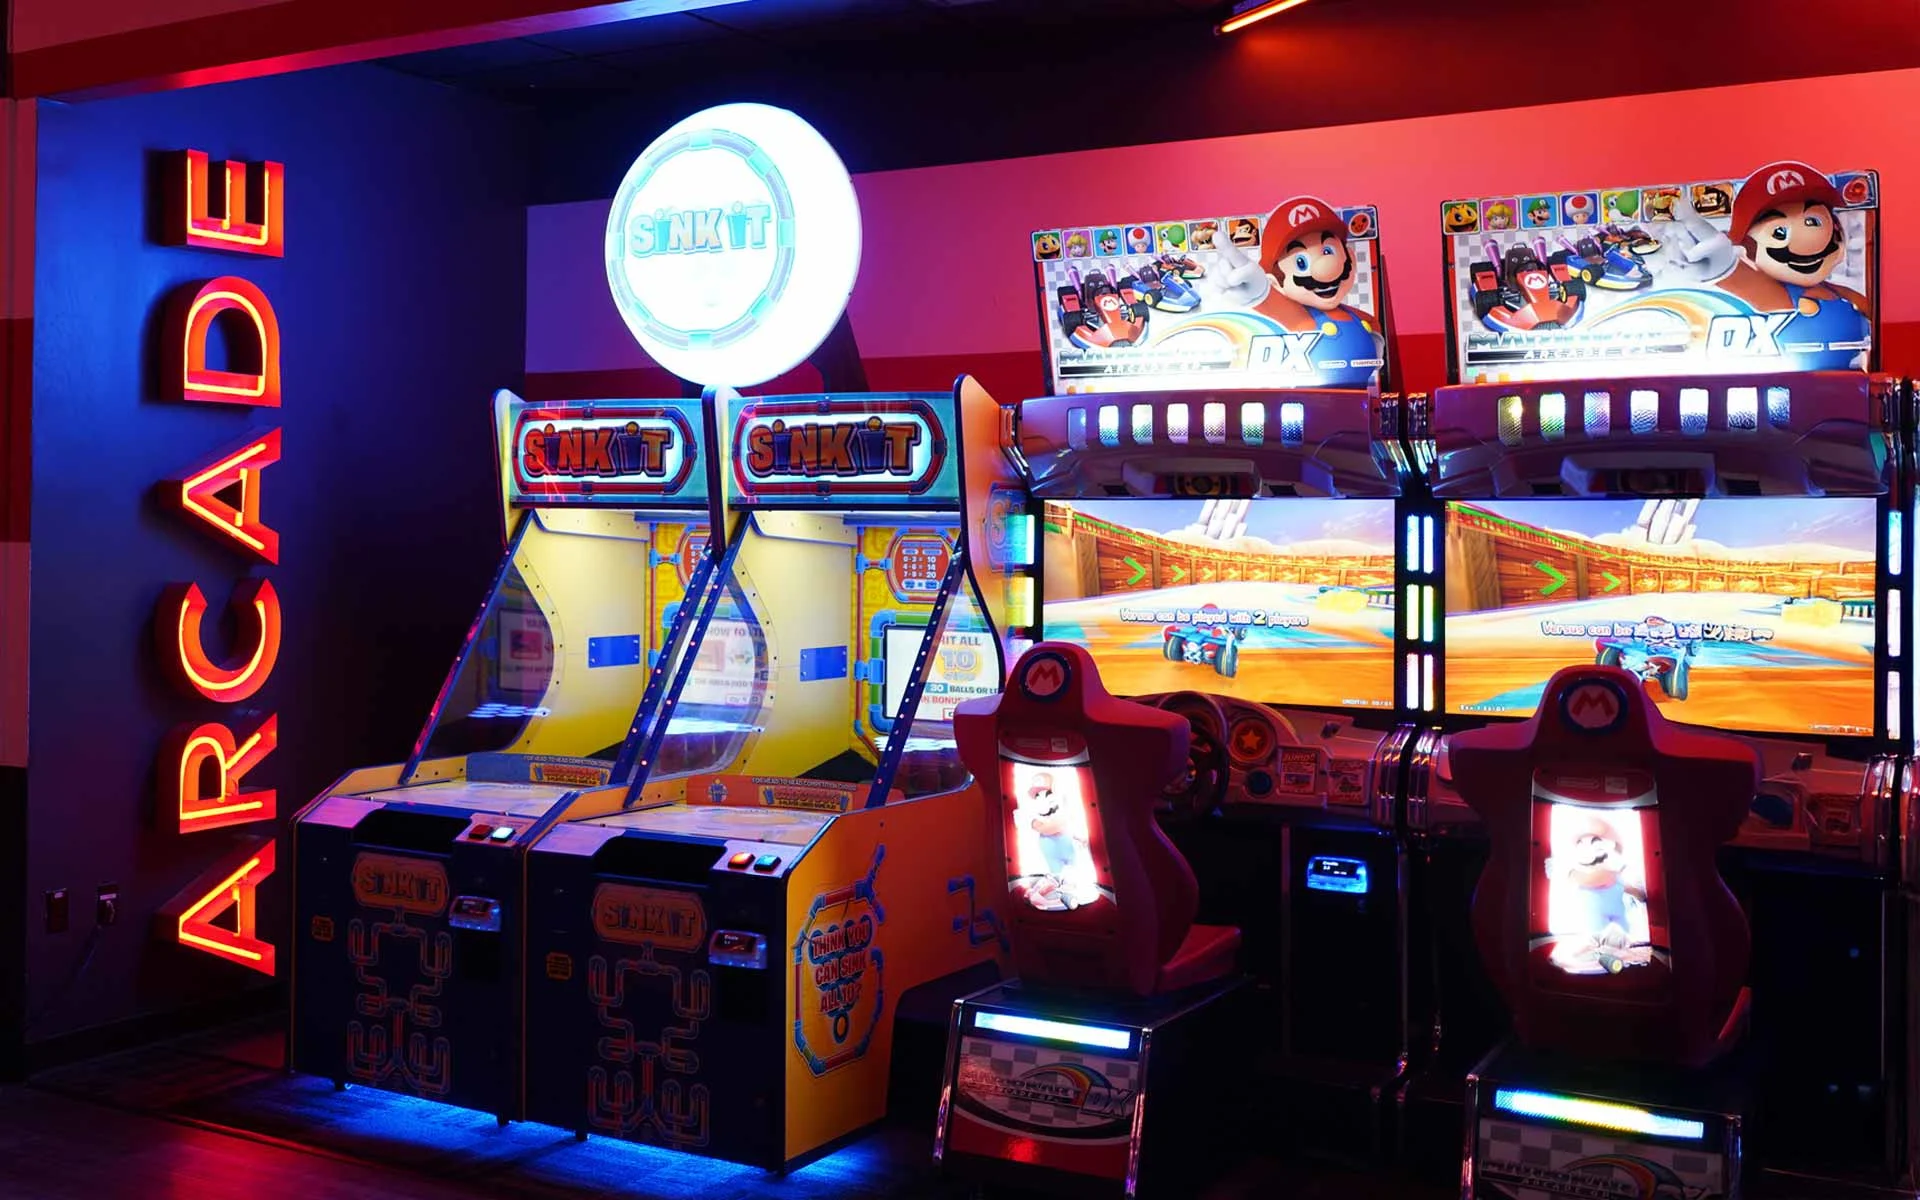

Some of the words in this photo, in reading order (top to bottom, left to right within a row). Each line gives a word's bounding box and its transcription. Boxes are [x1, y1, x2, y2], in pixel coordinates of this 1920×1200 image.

[1248, 331, 1325, 374] DX
[1707, 312, 1798, 358] DX
[521, 421, 615, 477] SINK
[747, 418, 856, 477] SINK
[178, 148, 285, 977] ARCADE
[1120, 607, 1155, 622] Versus
[1156, 611, 1175, 622] can
[1176, 609, 1191, 623] be
[1252, 609, 1267, 626] 2
[1541, 620, 1586, 636] Versus
[960, 636, 981, 646] ALL
[941, 648, 978, 671] 10
[949, 685, 975, 694] BALLS
[812, 929, 845, 959] THINK
[847, 921, 869, 948] YOU
[815, 958, 839, 985] CAN
[841, 950, 868, 977] SINK
[820, 989, 841, 1013] ALL
